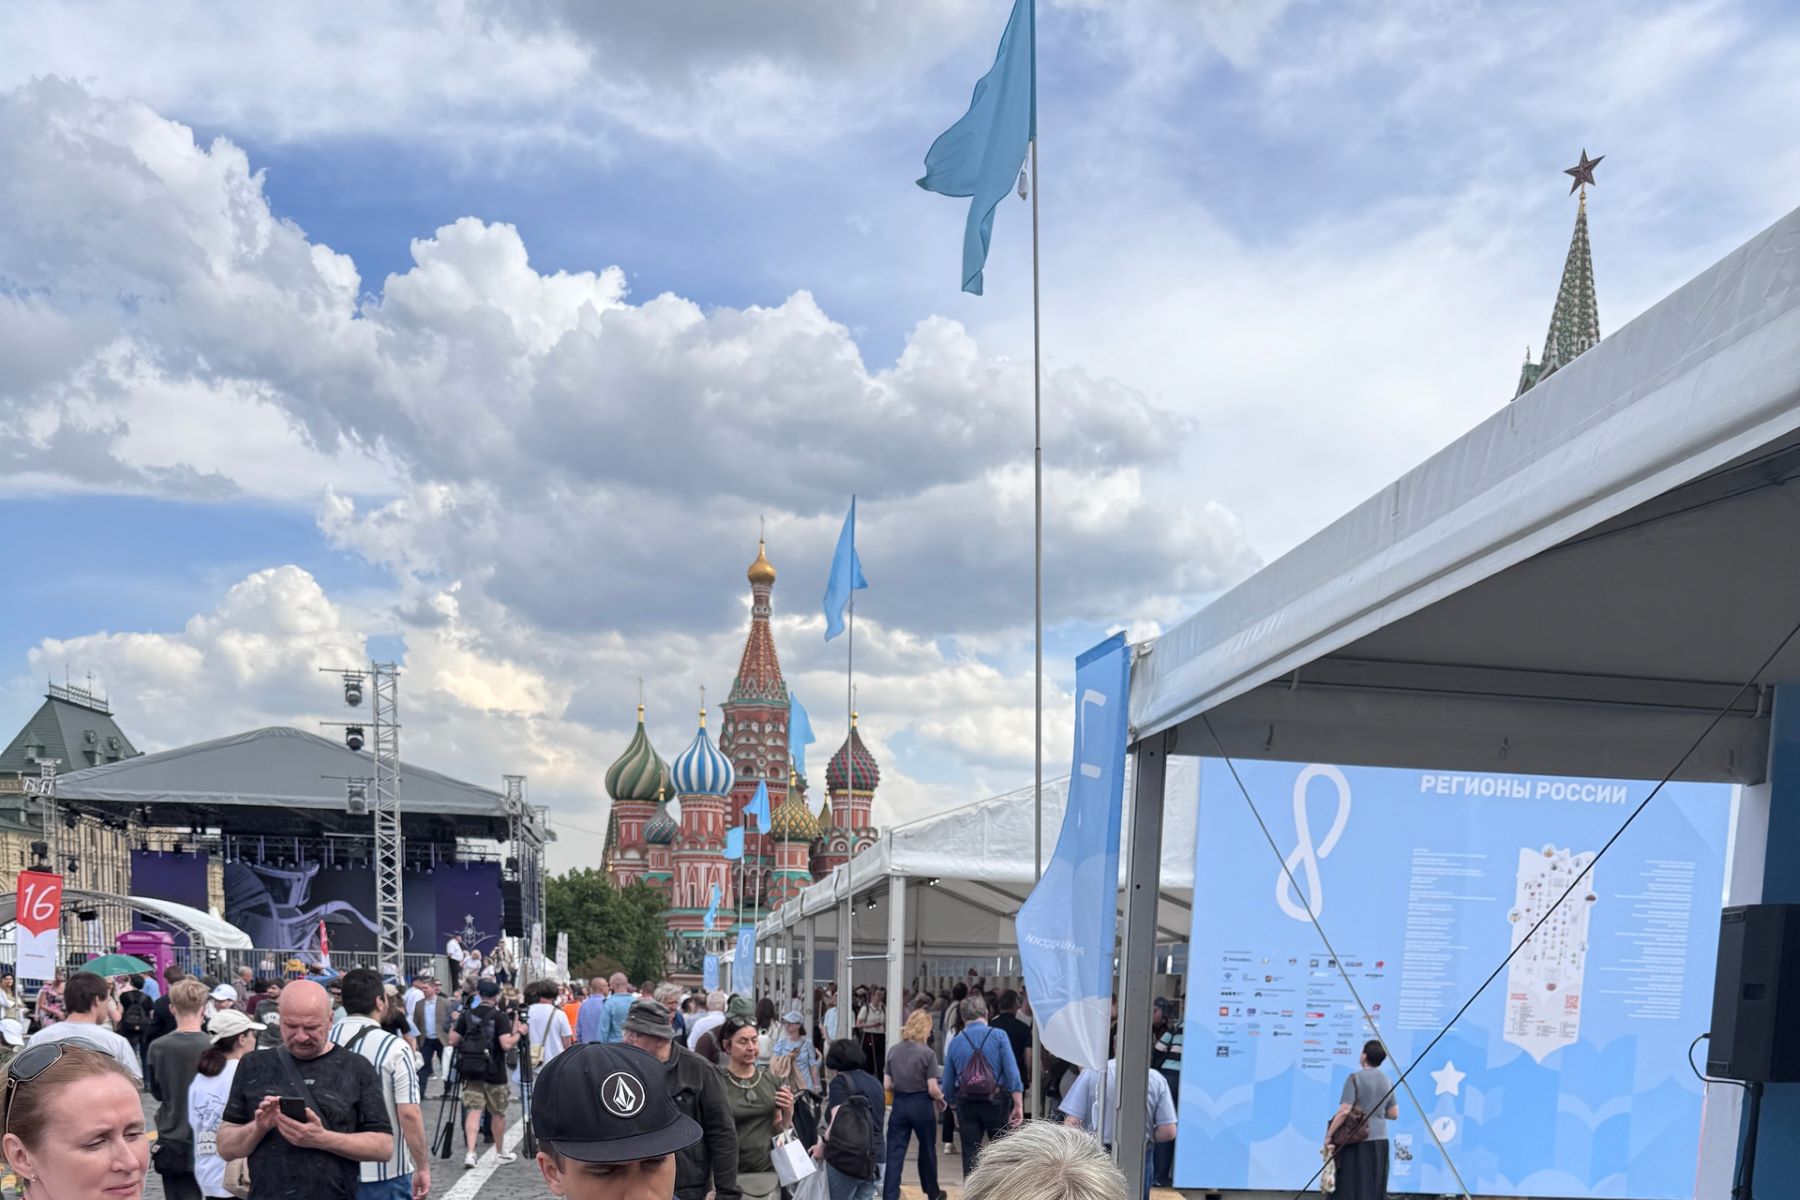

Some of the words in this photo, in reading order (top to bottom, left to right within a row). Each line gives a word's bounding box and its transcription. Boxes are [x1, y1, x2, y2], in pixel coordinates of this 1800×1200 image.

[1420, 774, 1531, 799] РЕГИОНЫ
[1535, 781, 1628, 805] РОССИИ
[23, 882, 57, 922] 16
